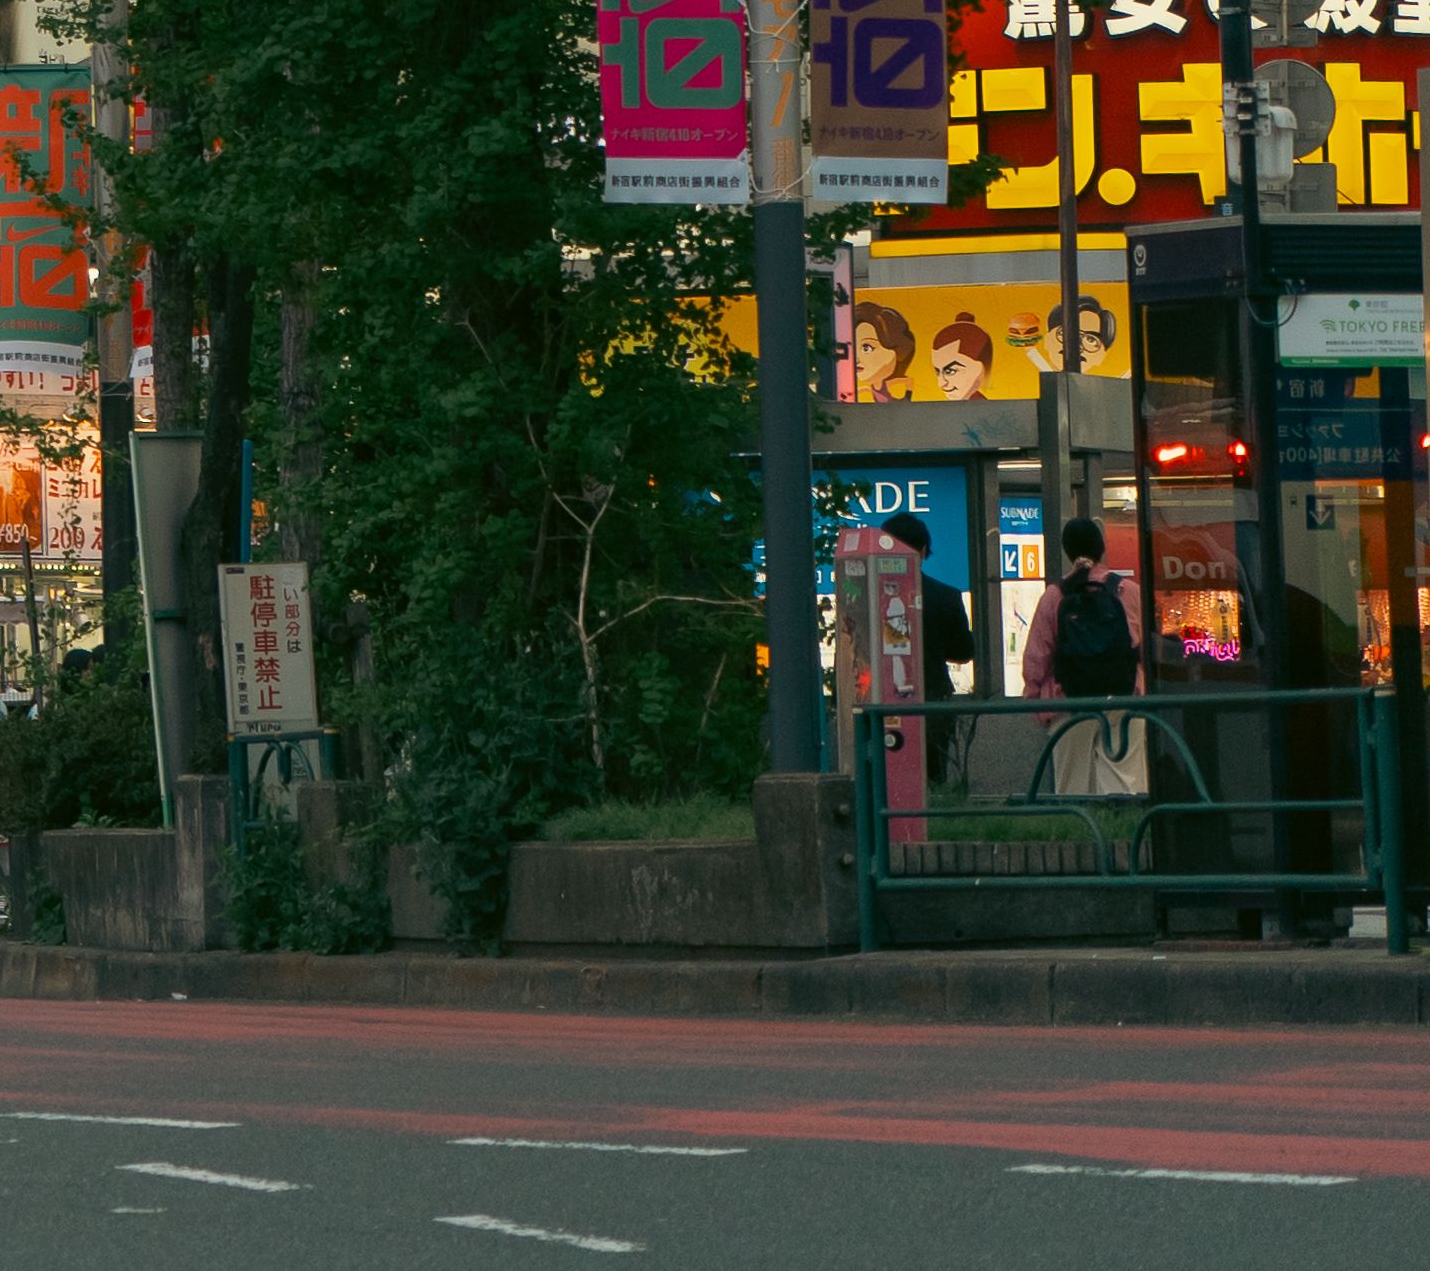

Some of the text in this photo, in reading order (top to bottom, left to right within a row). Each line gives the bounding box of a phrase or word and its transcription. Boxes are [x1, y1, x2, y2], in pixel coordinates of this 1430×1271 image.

[611, 174, 740, 188] 新宿駅前商店街振興組合
[819, 173, 940, 188] 新宿駅前商店街振興組合
[1339, 321, 1388, 333] TOKYO
[1000, 507, 1039, 519] SUBNADE
[1026, 552, 1036, 572] 6
[249, 575, 283, 710] 駐停車禁止
